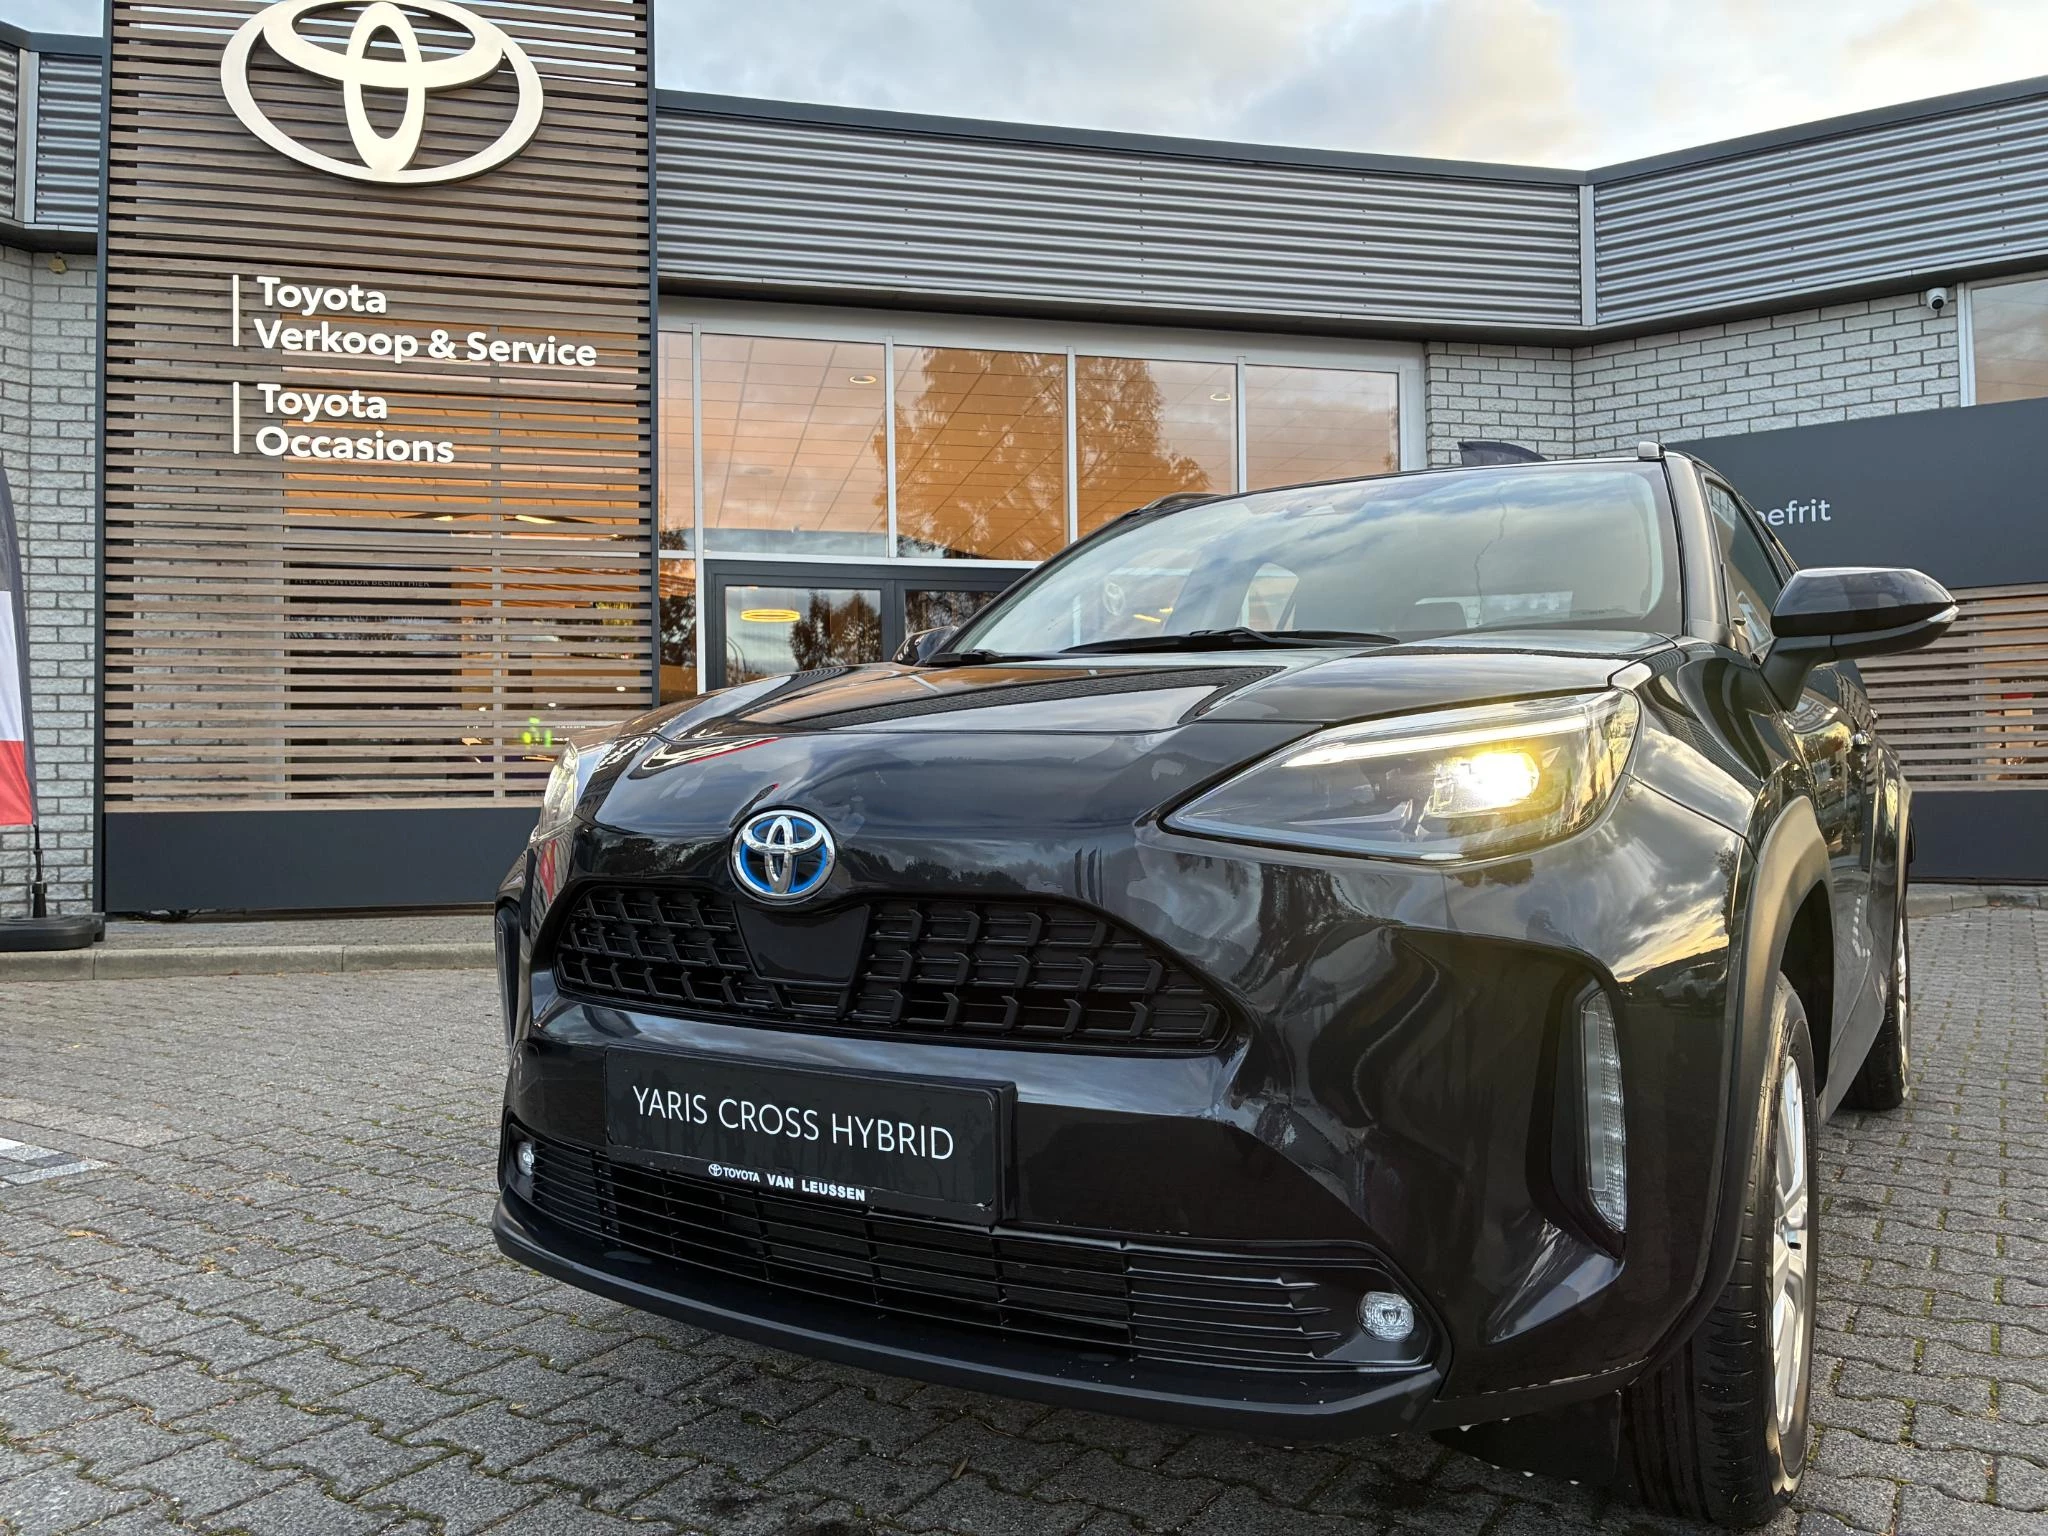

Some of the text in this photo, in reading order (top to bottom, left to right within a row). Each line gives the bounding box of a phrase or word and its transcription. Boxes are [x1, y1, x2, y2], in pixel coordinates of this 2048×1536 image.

[256, 276, 387, 316] Toyota
[253, 318, 598, 367] Verkoop & Service
[256, 383, 388, 422] Toyota
[255, 426, 455, 463] Occasions
[632, 1085, 954, 1160] YARIS CROSS HYBRID
[723, 1166, 866, 1202] TOYOTA VAN LEUSSEN
